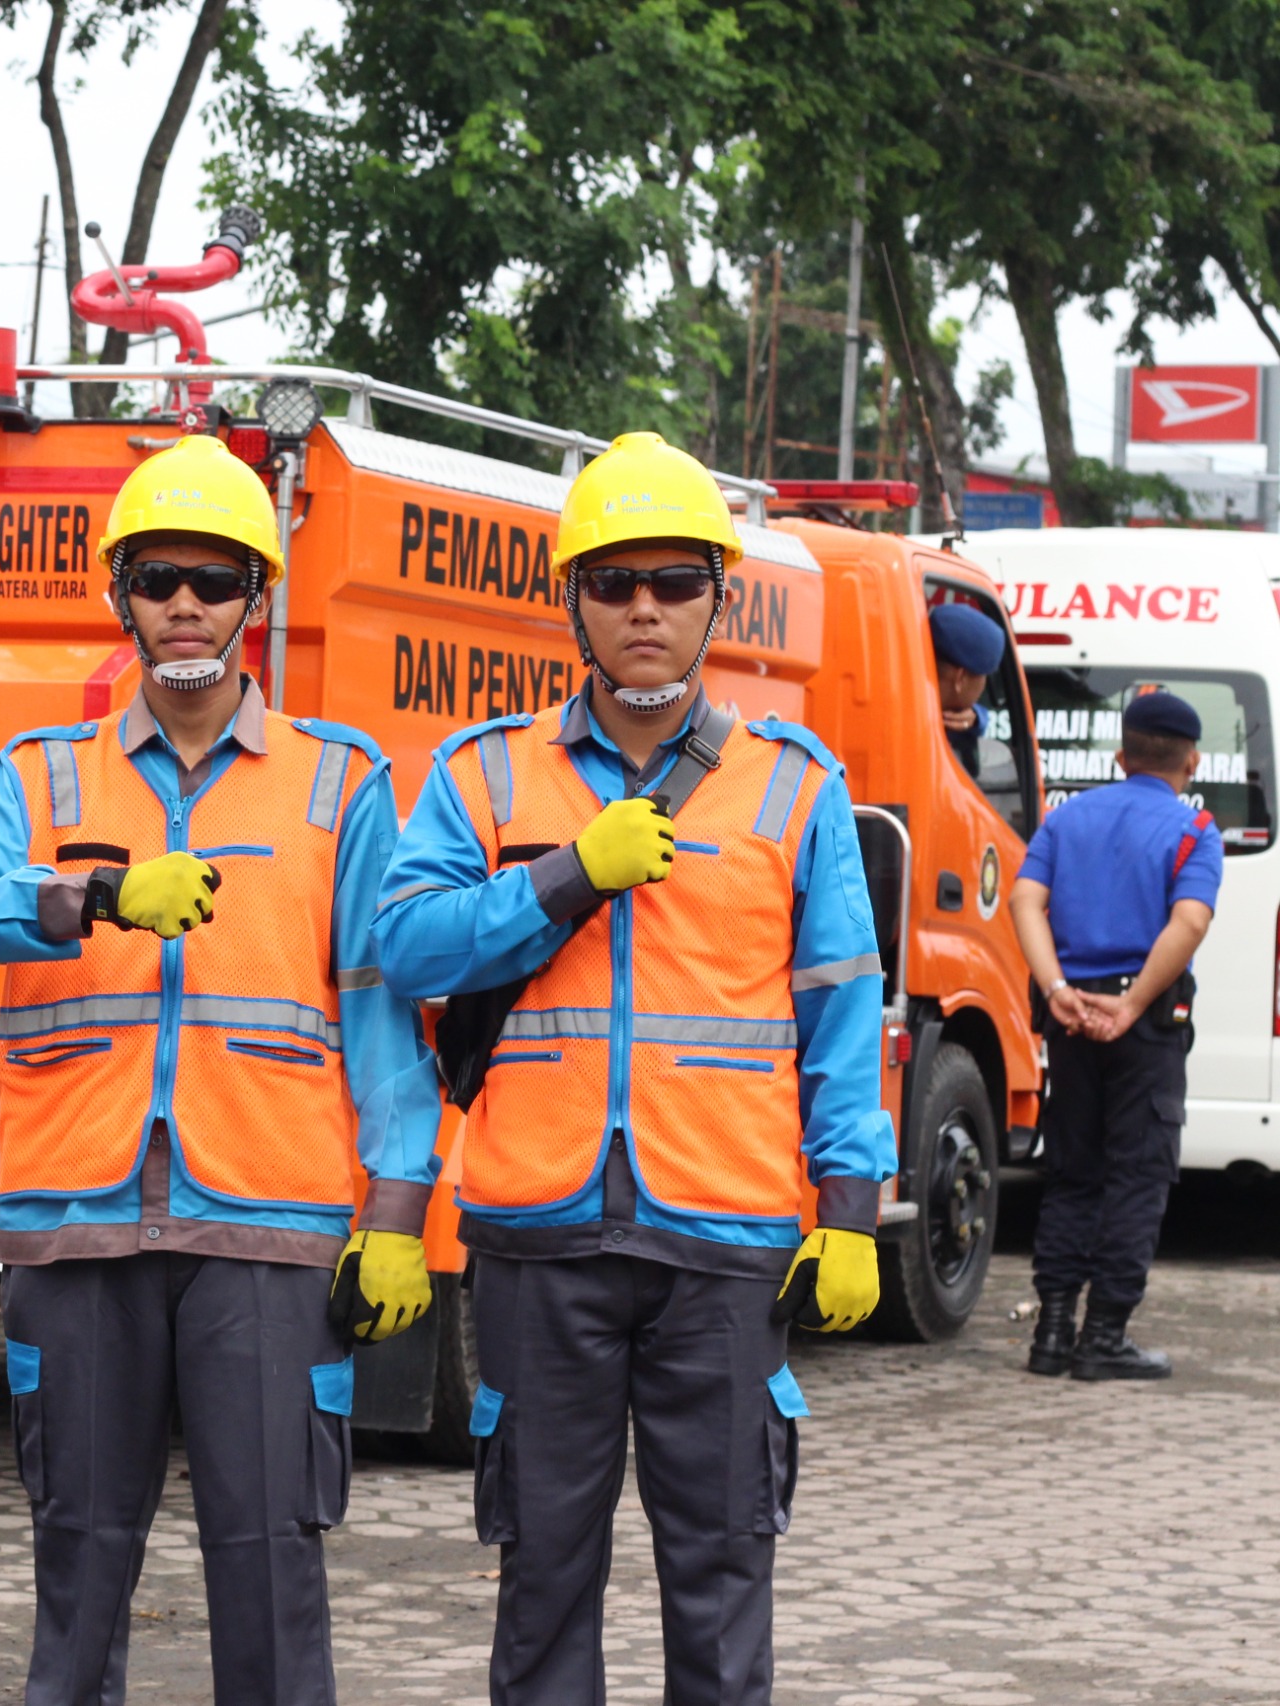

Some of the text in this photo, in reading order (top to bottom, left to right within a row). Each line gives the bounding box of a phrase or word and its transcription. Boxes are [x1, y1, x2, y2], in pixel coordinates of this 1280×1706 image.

[621, 492, 651, 505] PLN
[44, 581, 87, 599] UTARA
[394, 634, 457, 716] DAN
[1035, 709, 1089, 740] HAJI
[1188, 752, 1248, 784] ARA
